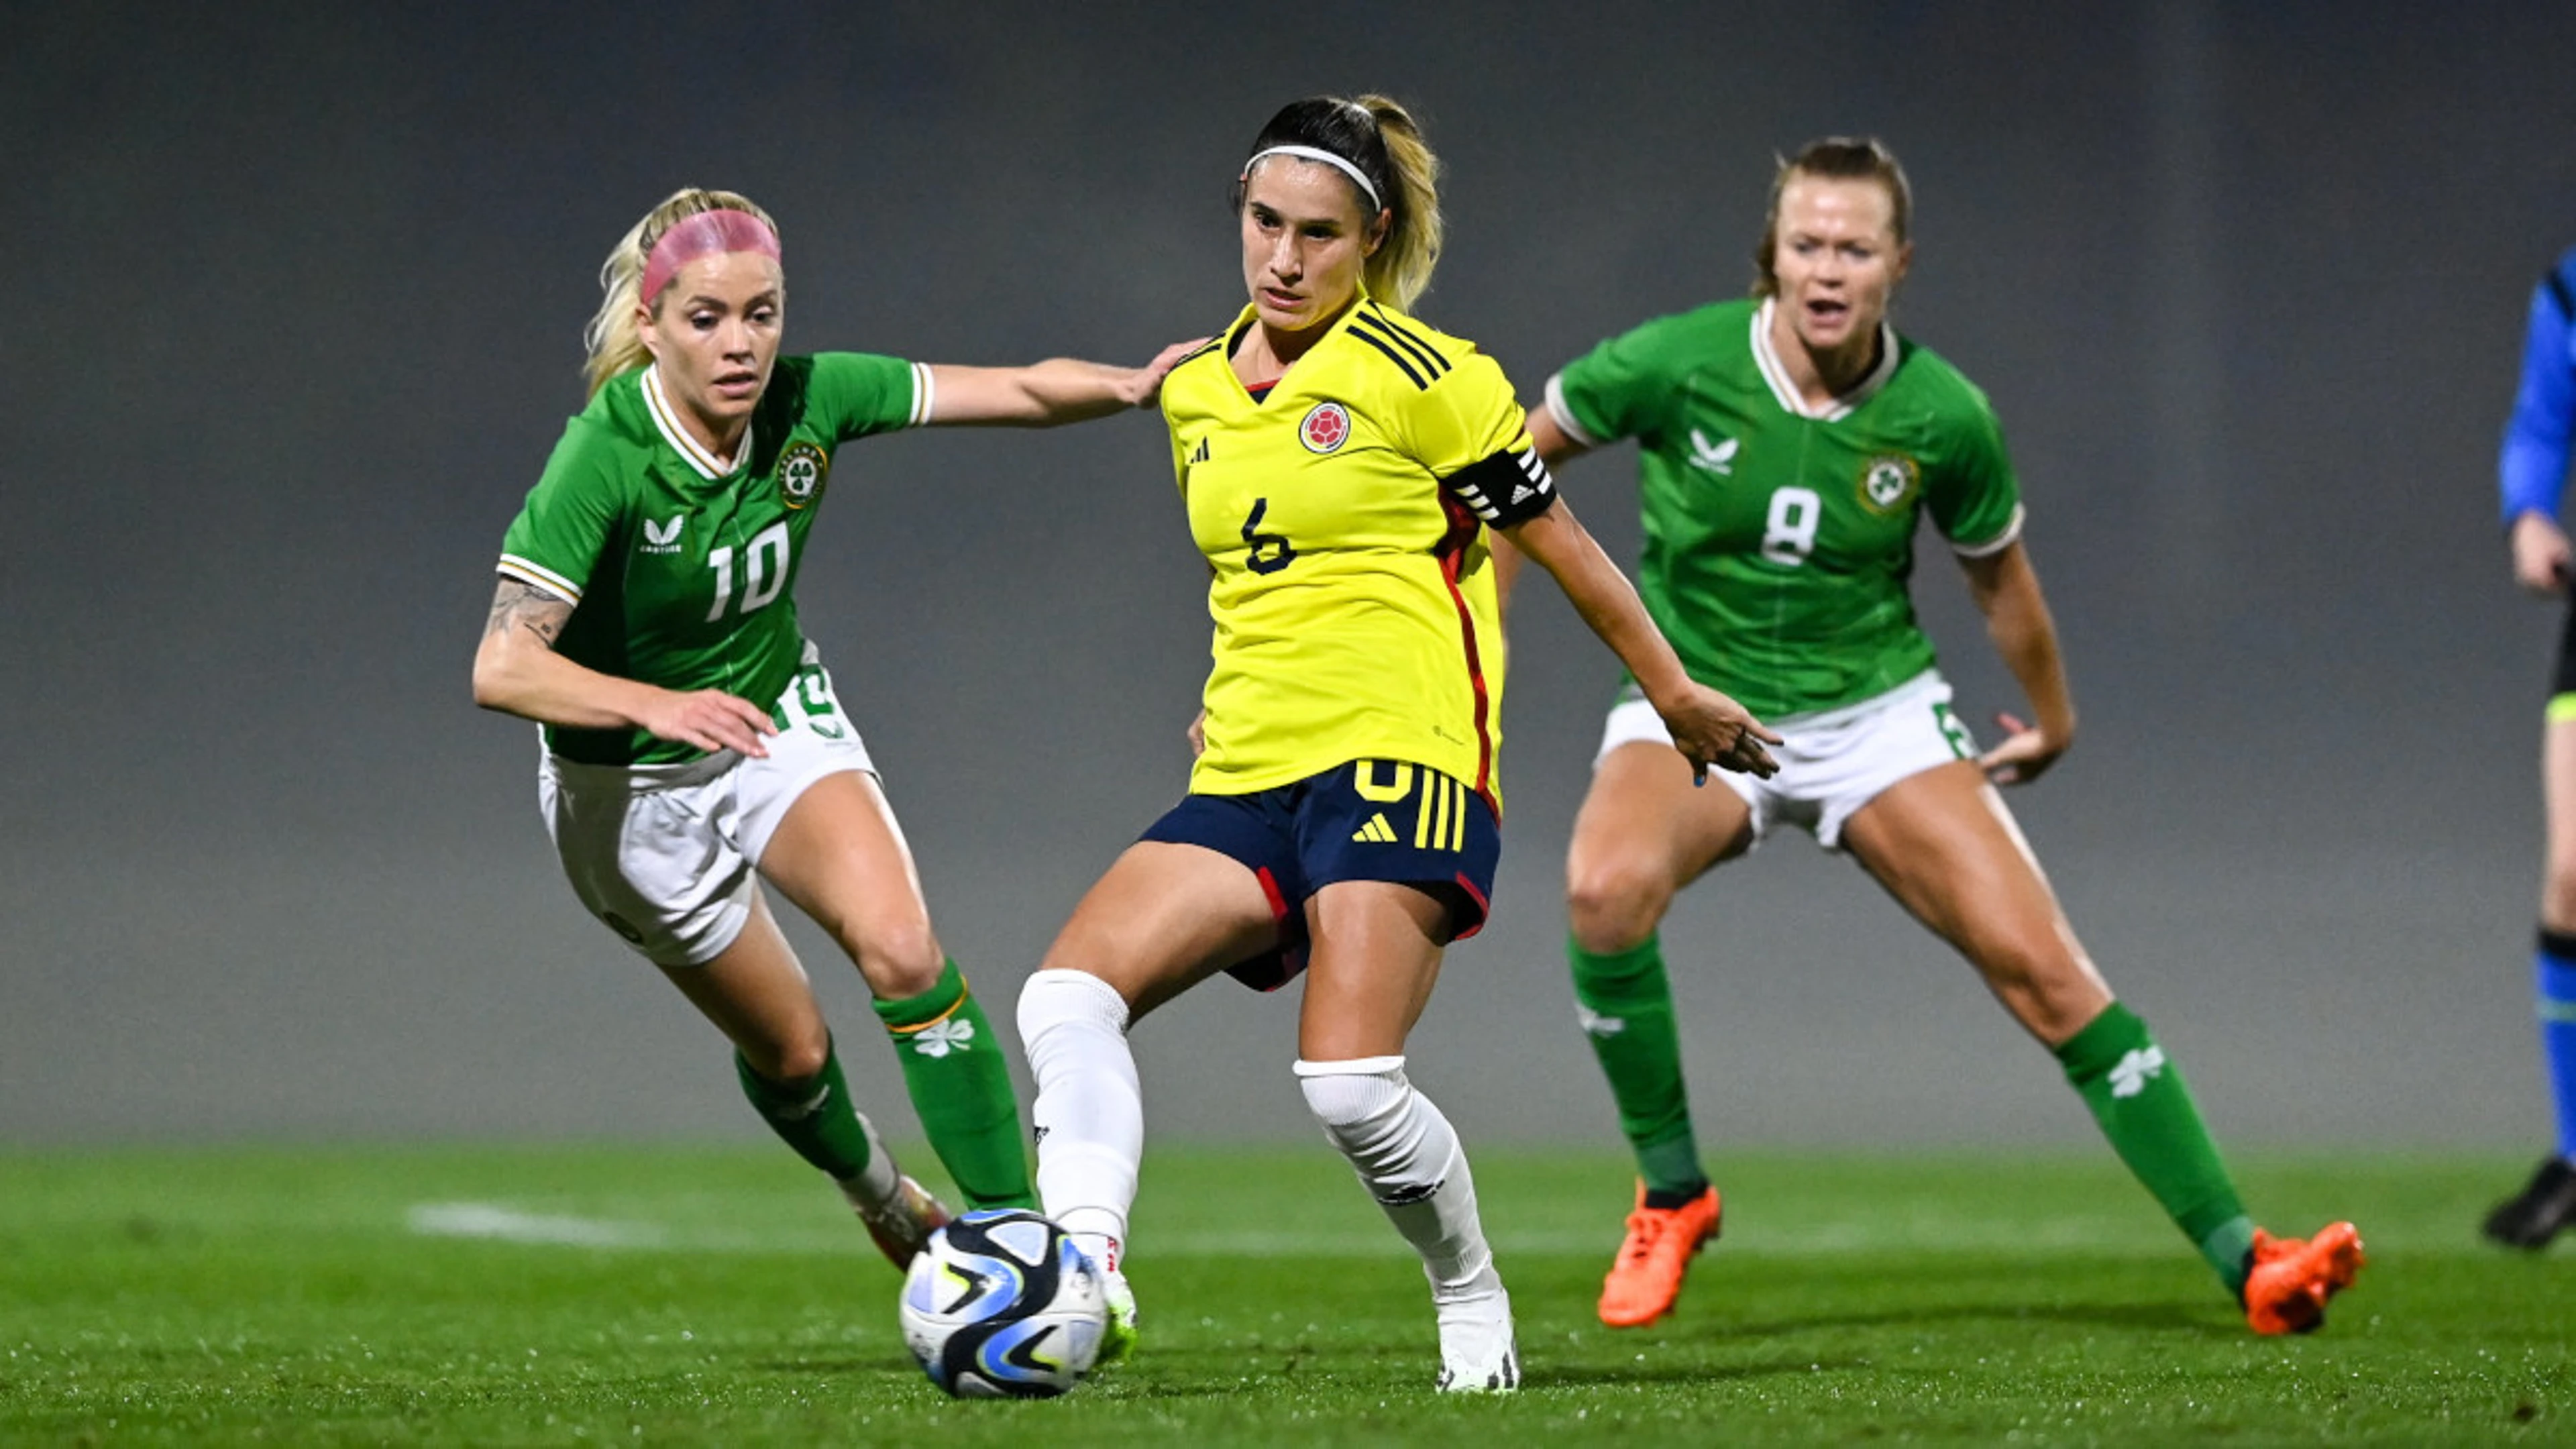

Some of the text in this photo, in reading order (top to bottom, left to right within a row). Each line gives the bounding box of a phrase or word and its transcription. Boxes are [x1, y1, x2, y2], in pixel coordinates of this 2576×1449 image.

[1241, 497, 1297, 576] 6
[1761, 486, 1821, 566] 8
[705, 520, 790, 623] 10
